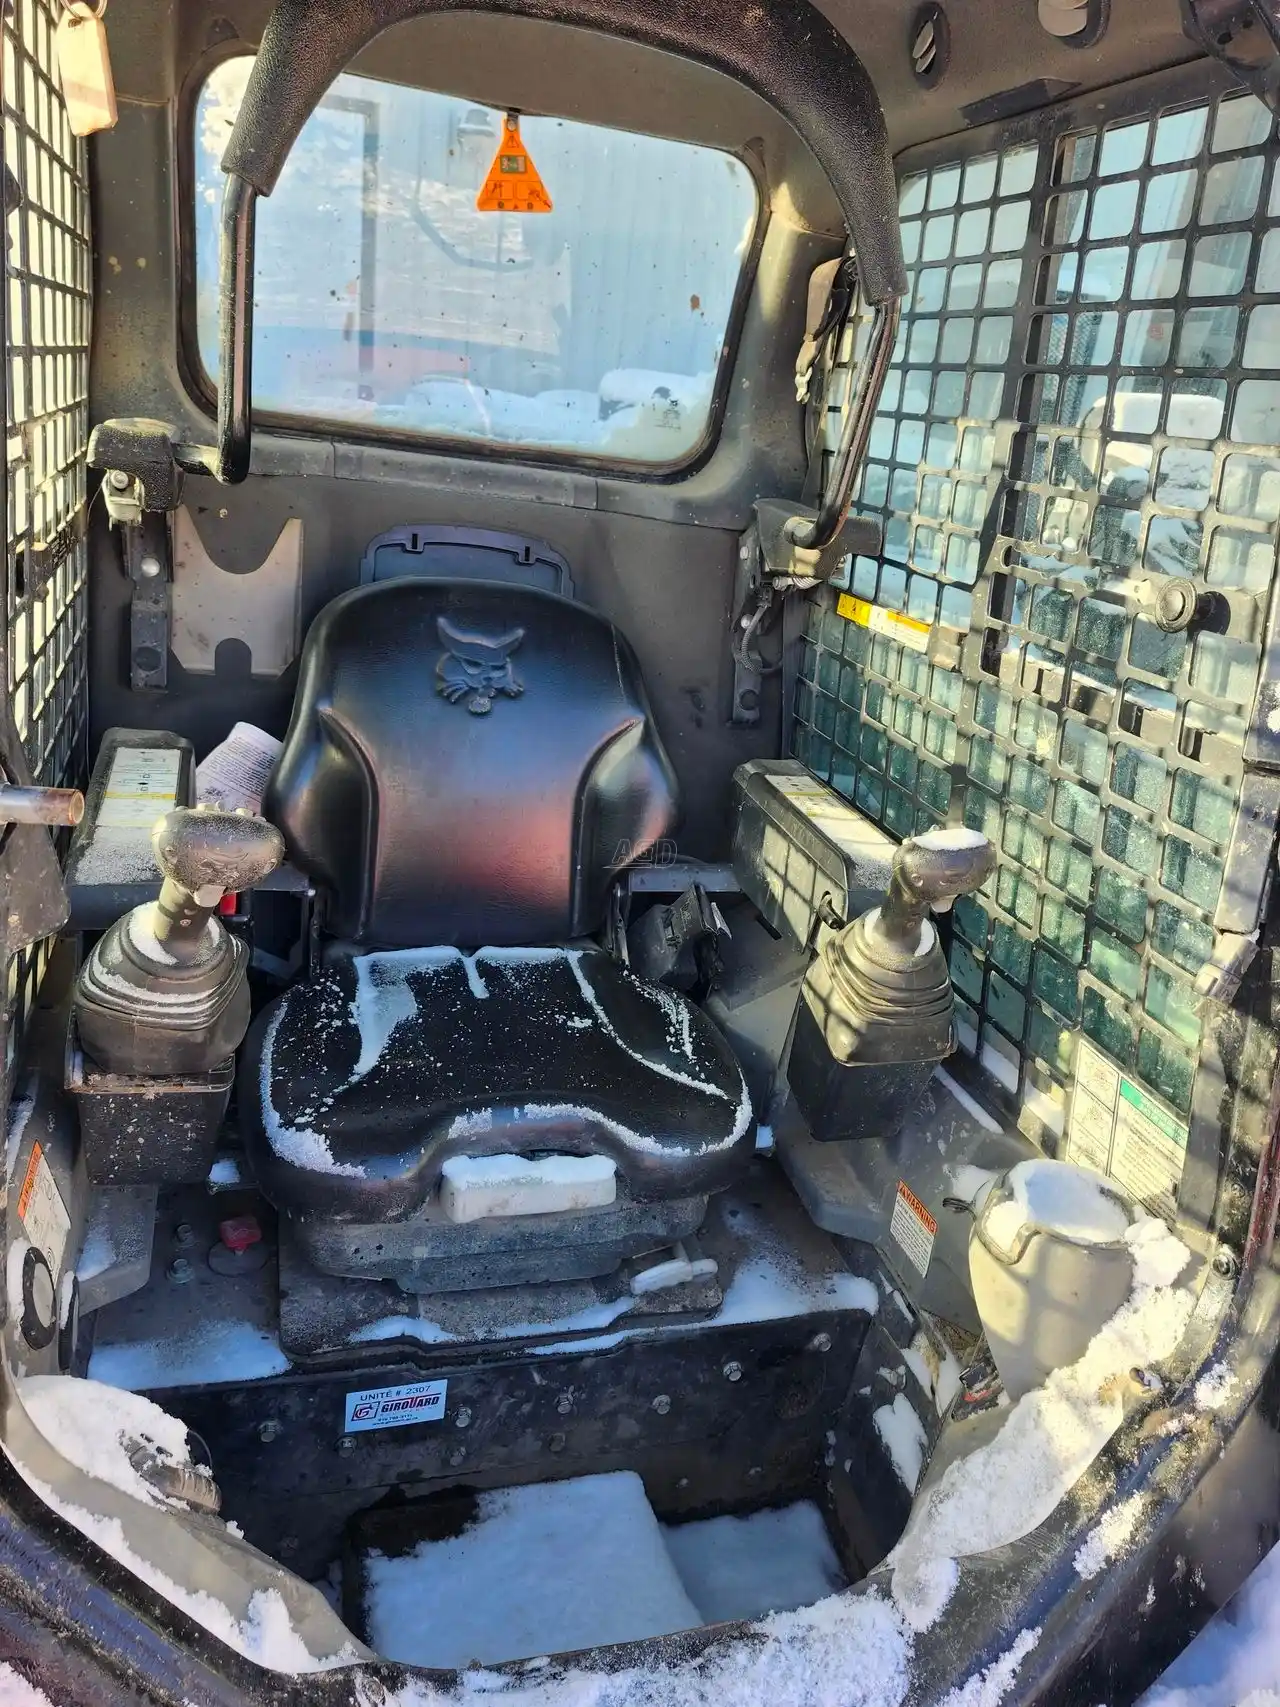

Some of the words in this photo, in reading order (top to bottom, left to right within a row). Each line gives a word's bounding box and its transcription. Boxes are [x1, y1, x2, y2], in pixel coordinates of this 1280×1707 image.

[904, 1188, 936, 1233] WARNING
[360, 1389, 393, 1402] UNITÉ
[405, 1385, 431, 1395] 2307
[381, 1396, 440, 1413] GIROUARD
